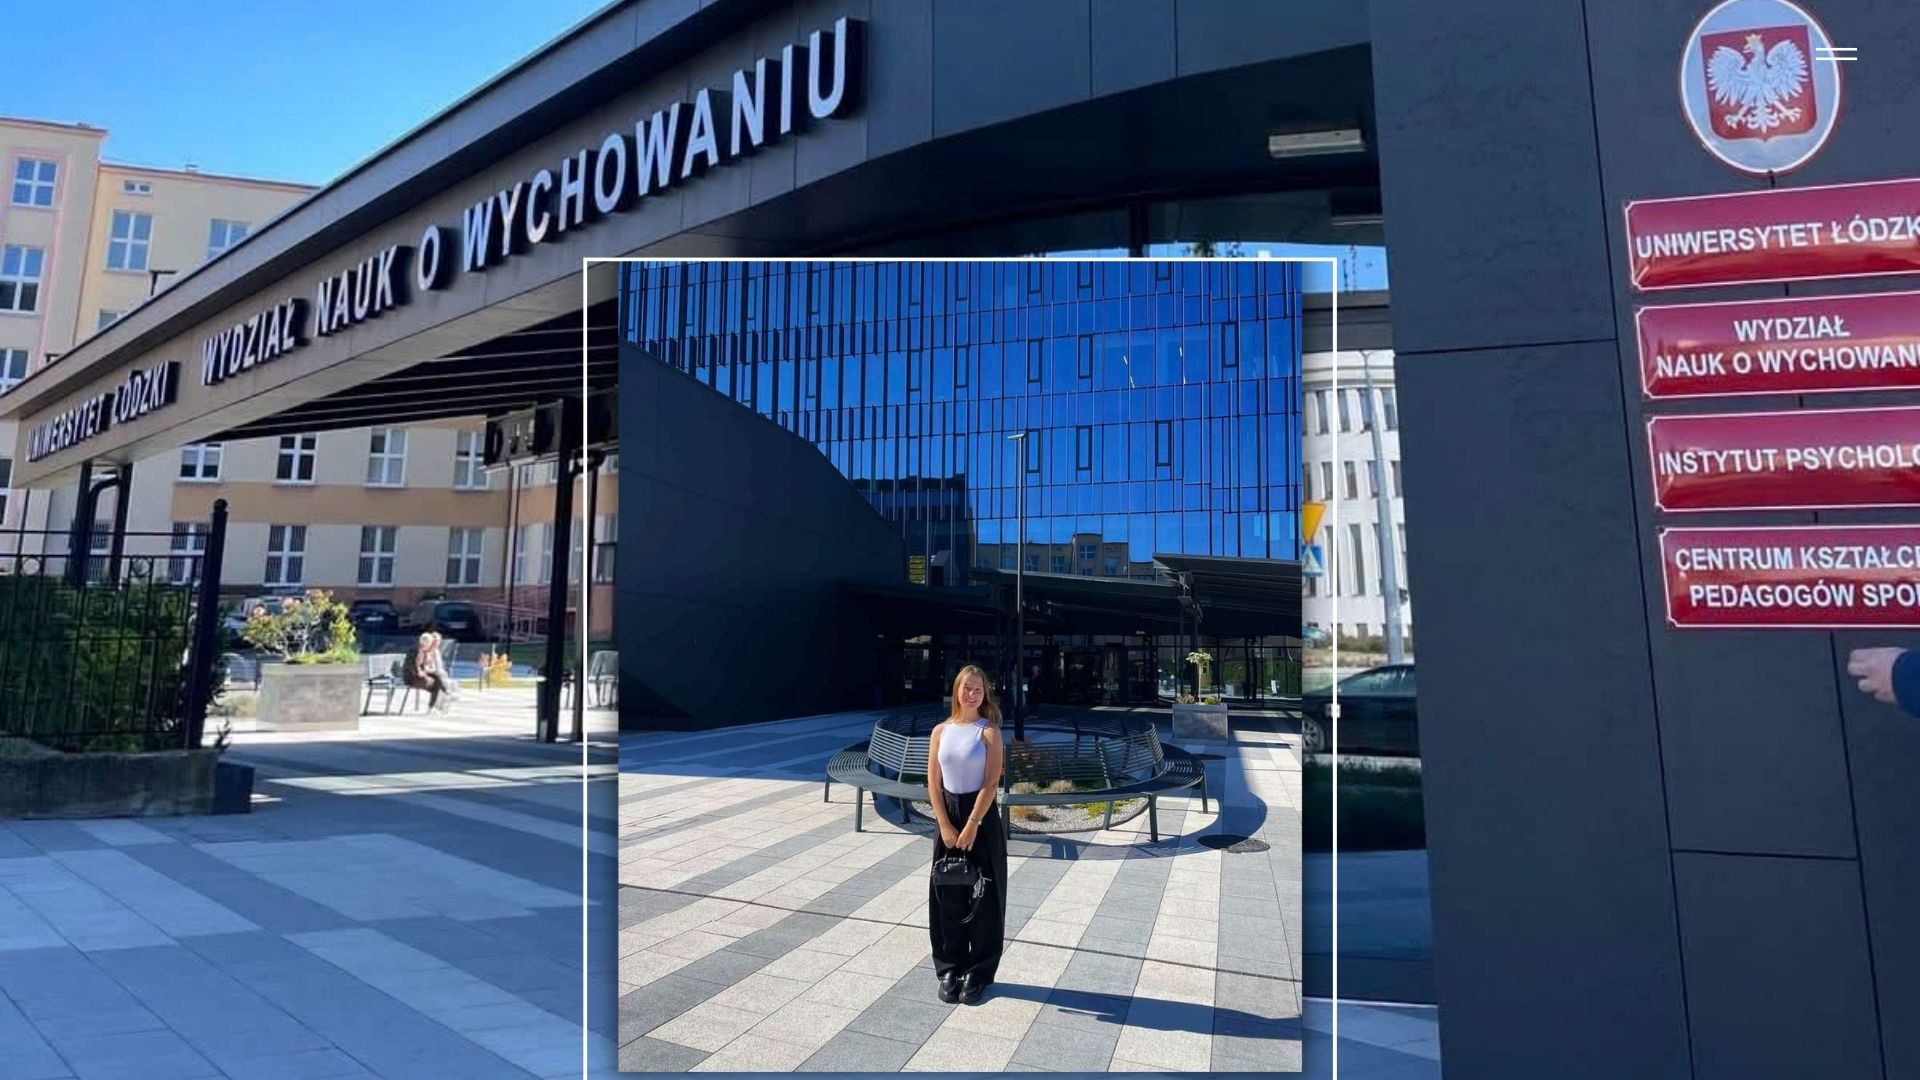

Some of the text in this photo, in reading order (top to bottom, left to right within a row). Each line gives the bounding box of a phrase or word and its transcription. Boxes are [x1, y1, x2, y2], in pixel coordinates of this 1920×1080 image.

[26, 17, 849, 462] UNIWERSYTET ŁÓDZKI WYDZIAŁ NAUK O WYCHOWANIU
[1636, 221, 1823, 258] UNIWERSYTET
[1734, 315, 1850, 342] WYDZIAŁ
[1656, 352, 1726, 378] NAUK
[1733, 351, 1752, 374] O
[1659, 448, 1778, 475] INSTYTUT
[1675, 547, 1793, 571] CENTRUM
[1689, 579, 1920, 608] PEDAGOGÓW SPO
